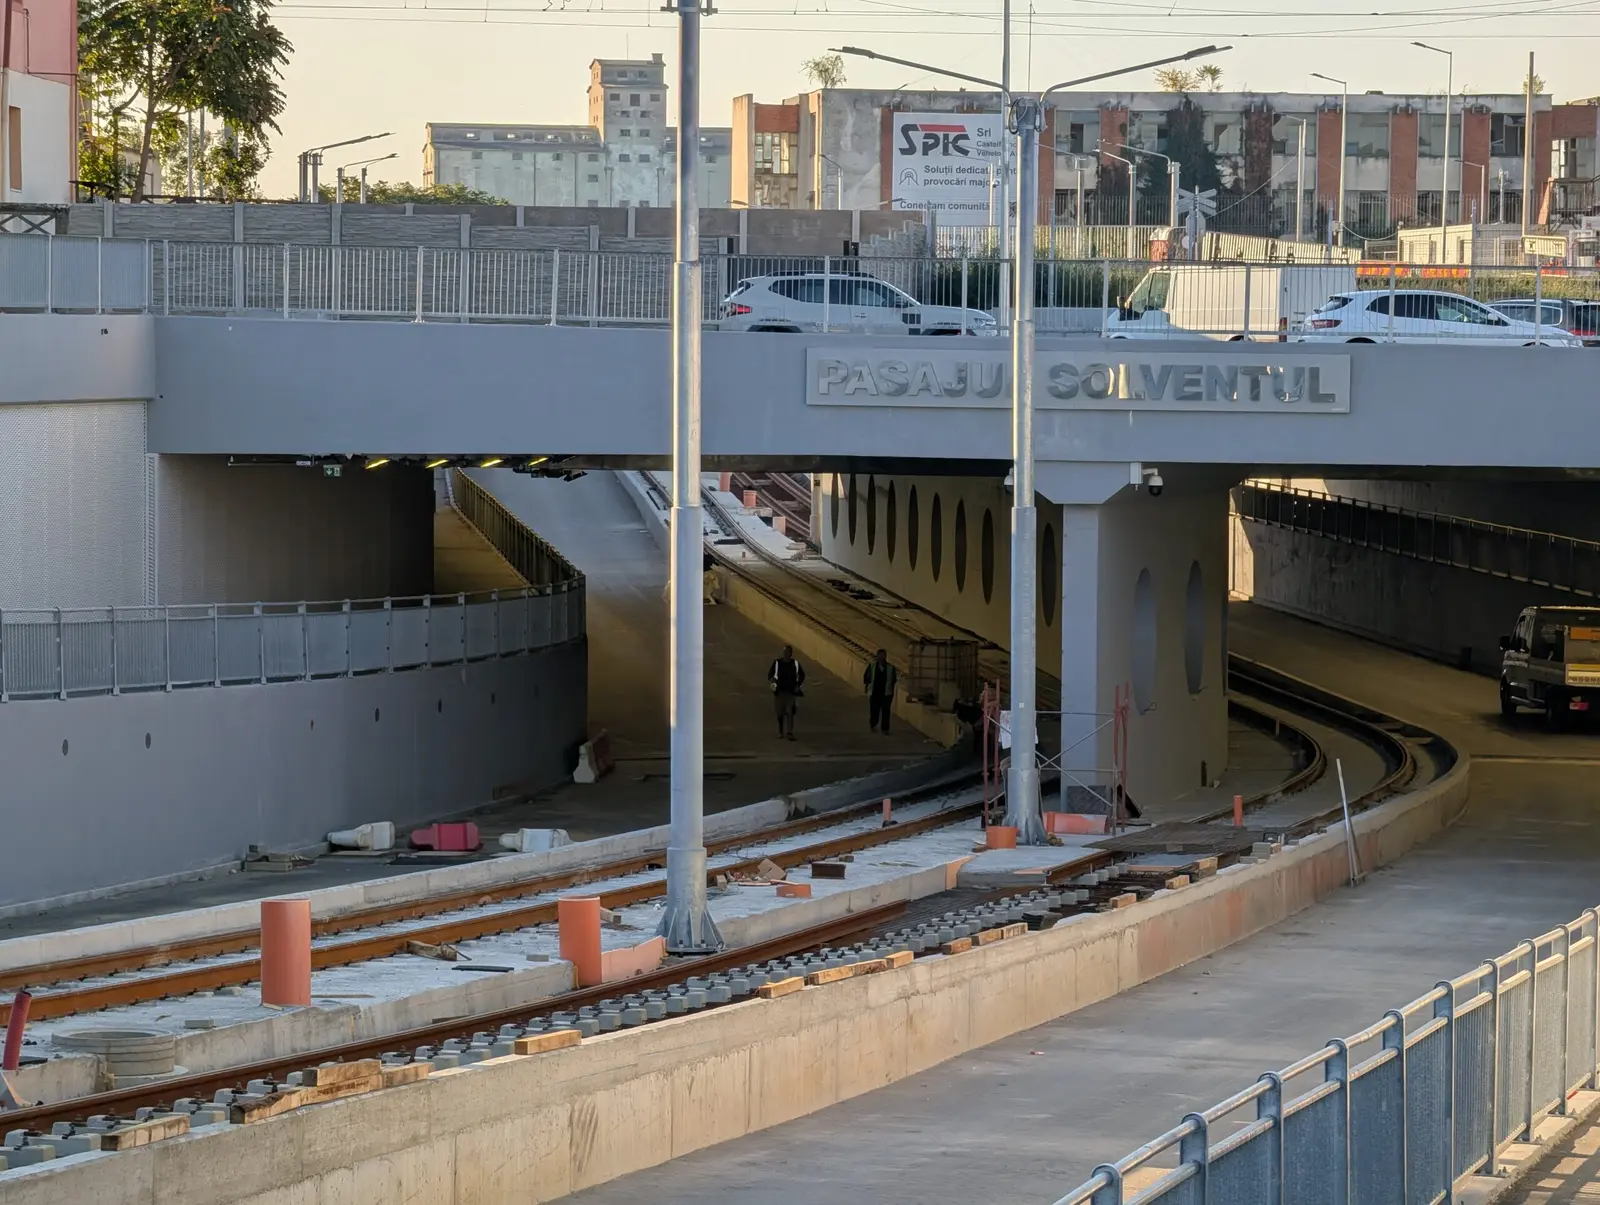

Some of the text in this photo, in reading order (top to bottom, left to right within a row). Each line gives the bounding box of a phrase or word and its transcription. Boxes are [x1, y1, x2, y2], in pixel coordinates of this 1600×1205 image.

[976, 127, 992, 137] Srl
[923, 165, 953, 175] Soluții
[923, 178, 967, 188] provocări
[818, 360, 1336, 403] PASAJU SOLVENTUL
